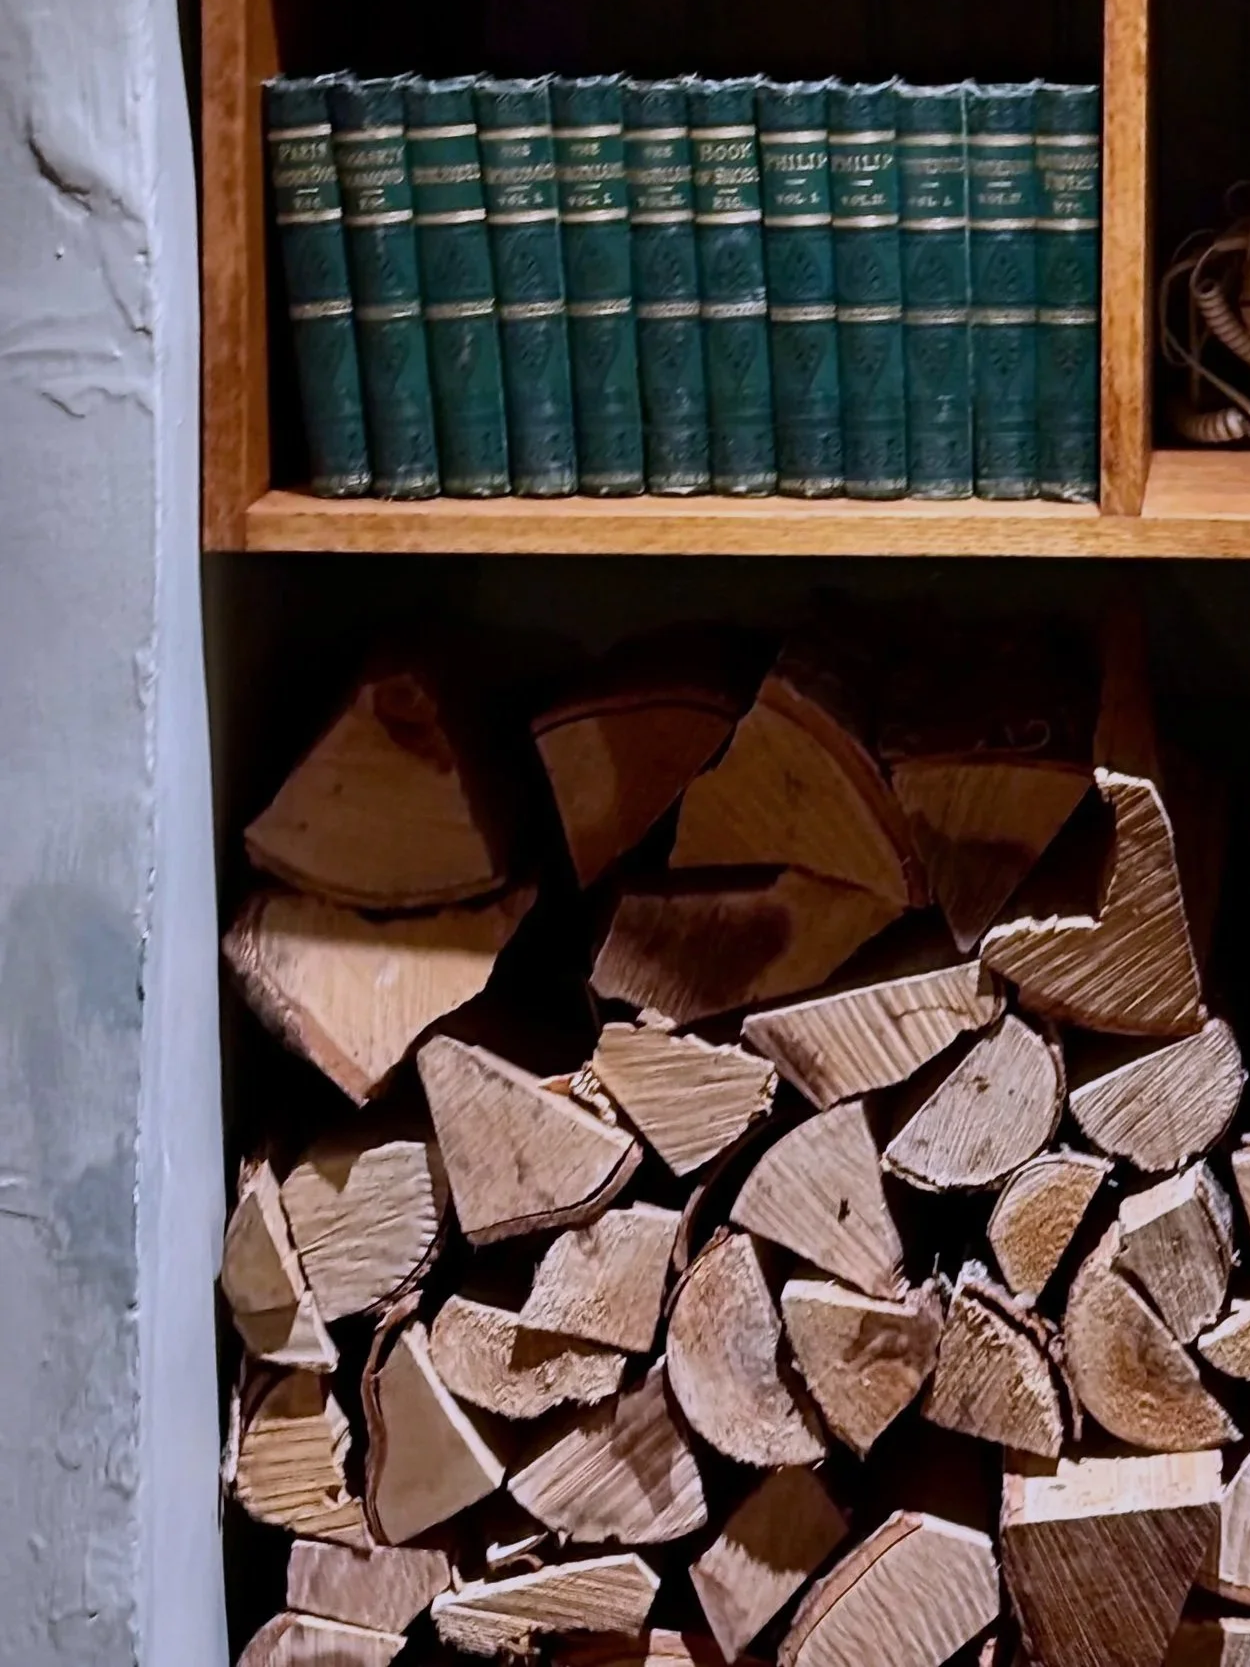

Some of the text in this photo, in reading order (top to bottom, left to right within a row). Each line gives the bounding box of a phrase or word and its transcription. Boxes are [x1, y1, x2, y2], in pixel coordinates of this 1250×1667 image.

[699, 142, 754, 162] BOOK
[764, 152, 828, 172] PHILIP
[831, 153, 894, 173] PHILIP
